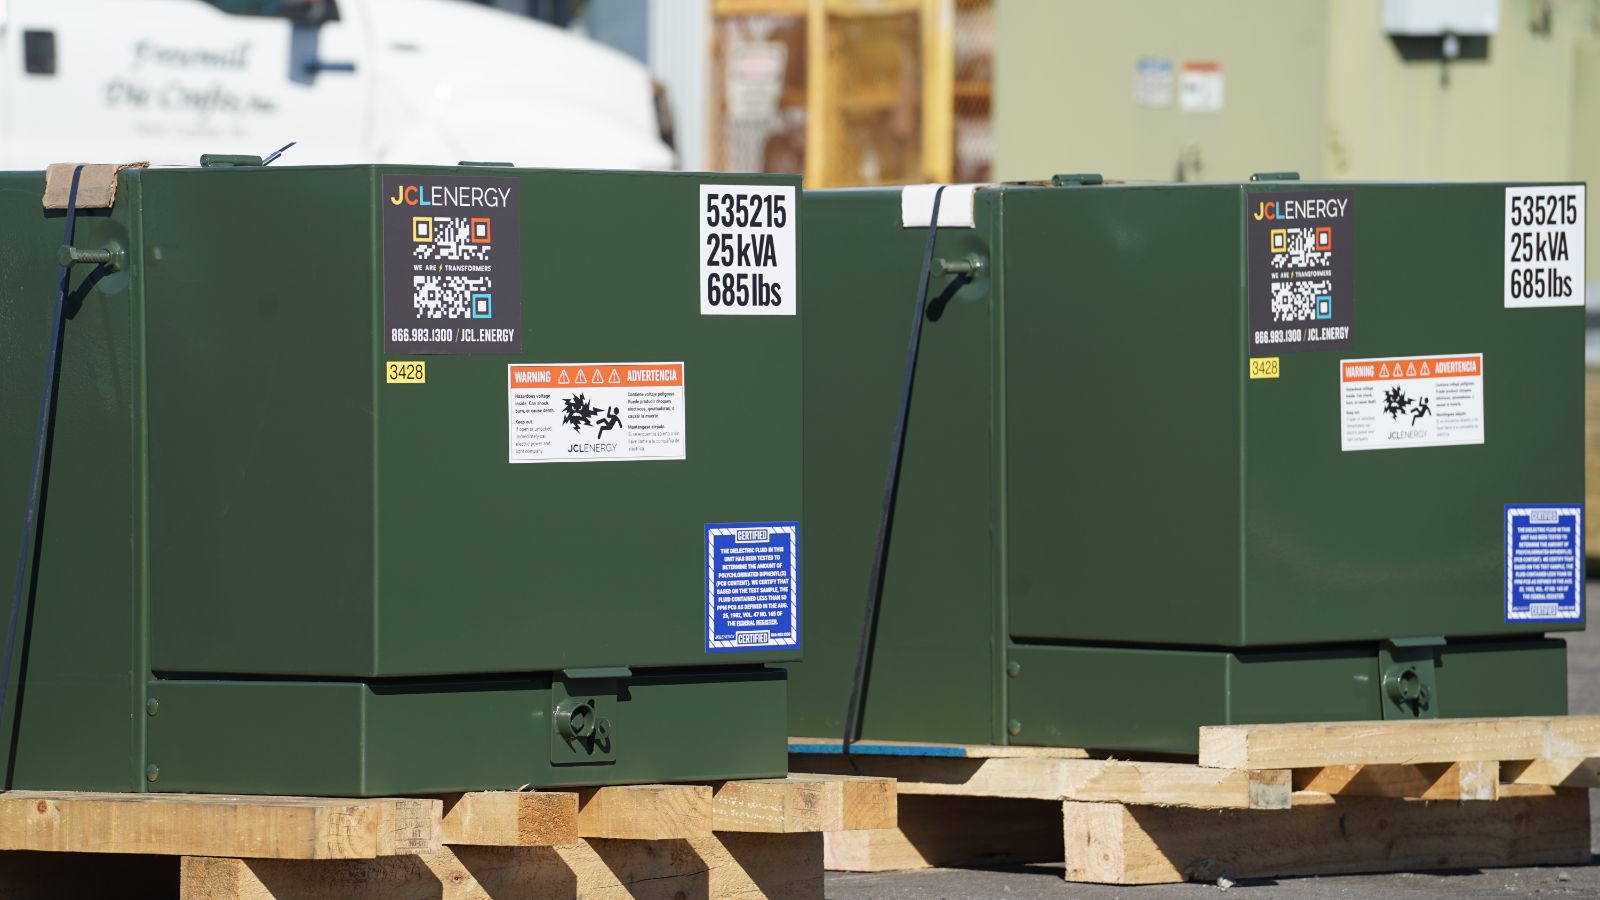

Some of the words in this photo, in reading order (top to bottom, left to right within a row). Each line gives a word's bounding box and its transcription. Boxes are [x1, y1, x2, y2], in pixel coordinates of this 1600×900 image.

[391, 186, 510, 207] JCLENERGY
[707, 194, 786, 228] 535215
[1254, 198, 1348, 220] JCLENERGY
[1511, 195, 1577, 225] 535215
[392, 328, 452, 342] 866.983.1300
[1255, 329, 1301, 344] 866.983.1300
[389, 364, 423, 380] 3428
[515, 371, 551, 383] WARNING
[627, 369, 677, 382] ADVERTENCIA
[1253, 360, 1278, 376] 3428
[1346, 365, 1374, 378] WARNING
[1435, 361, 1476, 374] ADVERTENCIA
[568, 443, 618, 453] JCLENERGY
[738, 530, 767, 541] CERTIFIED
[739, 632, 767, 644] CERTIFIED
